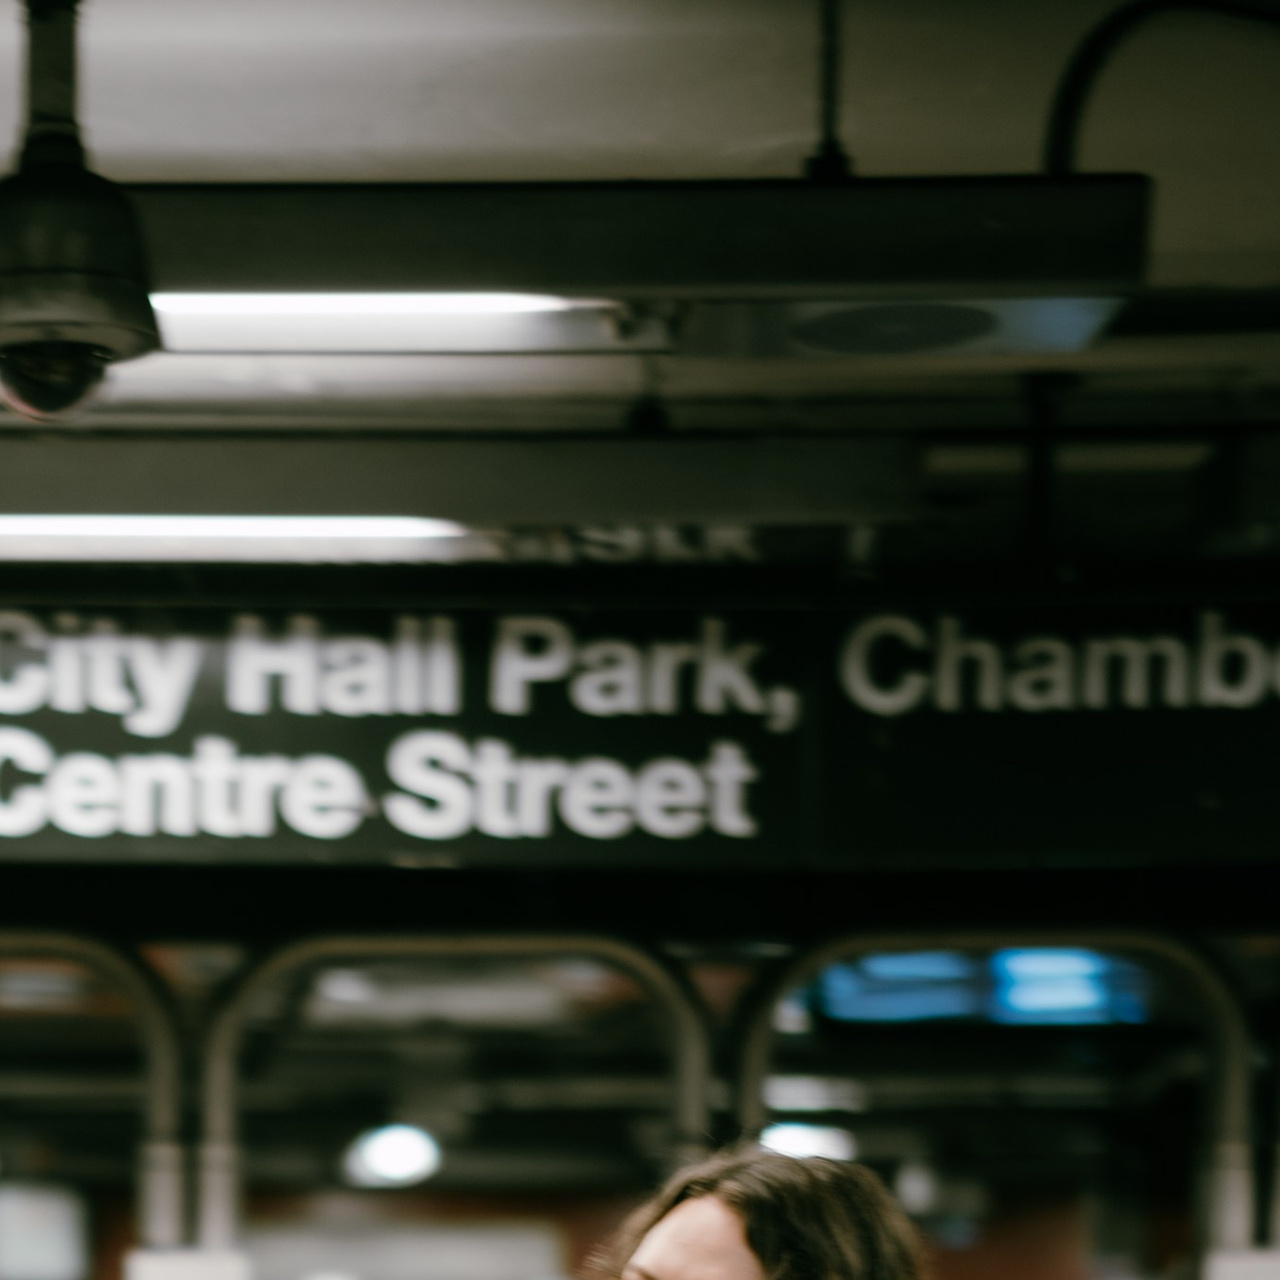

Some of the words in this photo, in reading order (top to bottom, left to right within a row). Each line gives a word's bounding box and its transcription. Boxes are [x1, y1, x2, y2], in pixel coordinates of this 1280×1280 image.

[227, 613, 461, 716] Hall
[490, 616, 798, 732] Park,
[842, 613, 1280, 715] Chamb
[384, 730, 758, 839] Street
